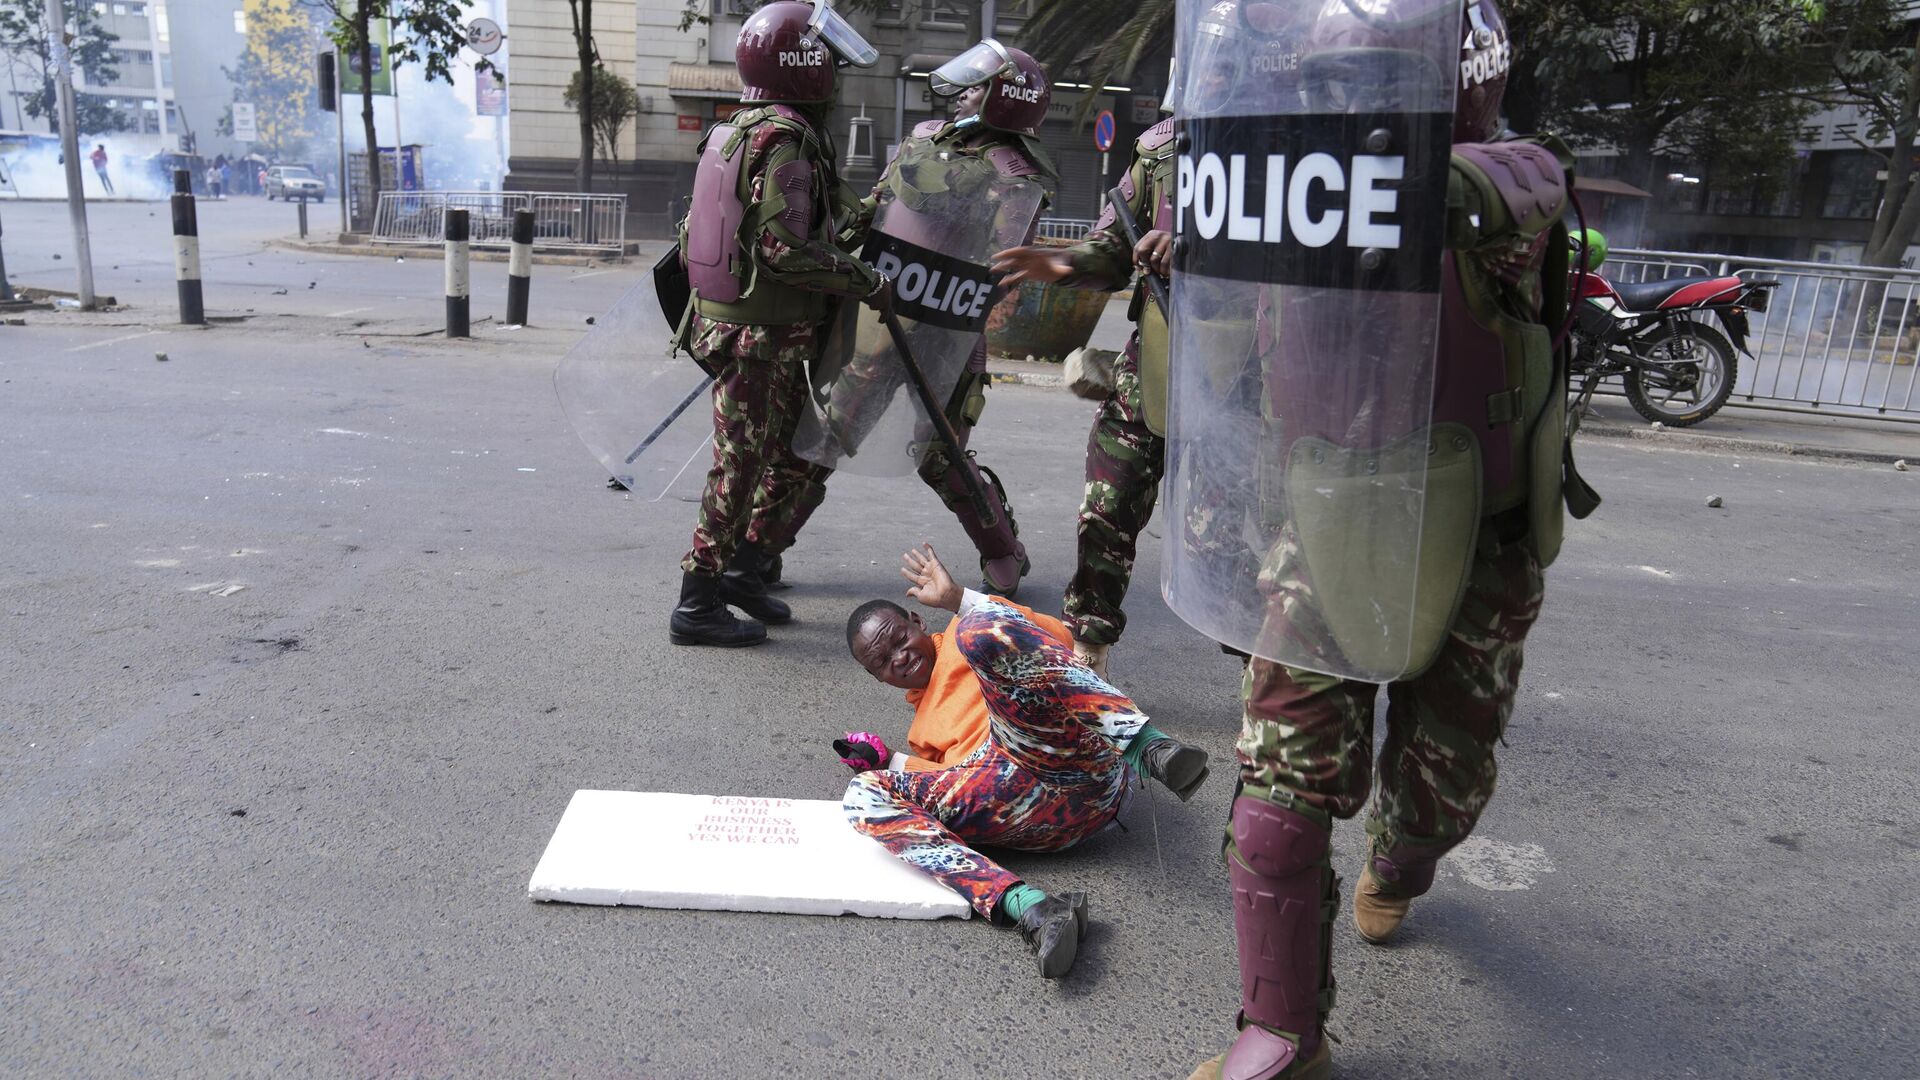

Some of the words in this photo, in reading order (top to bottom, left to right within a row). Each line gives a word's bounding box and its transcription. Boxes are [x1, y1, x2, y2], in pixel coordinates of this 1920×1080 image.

[779, 50, 822, 67] POLICE
[1252, 53, 1297, 73] POLICE
[1461, 40, 1510, 90] POLICE
[1001, 84, 1039, 104] POLICE
[1176, 152, 1405, 249] POLICE
[876, 250, 993, 318] POLICE
[712, 797, 770, 807] KENYA
[730, 807, 769, 816] OUR
[704, 815, 792, 826] BUSINESS
[695, 824, 797, 835] TOGETHER
[688, 833, 721, 842] YES
[727, 835, 757, 843] WE
[762, 836, 800, 845] CAN
